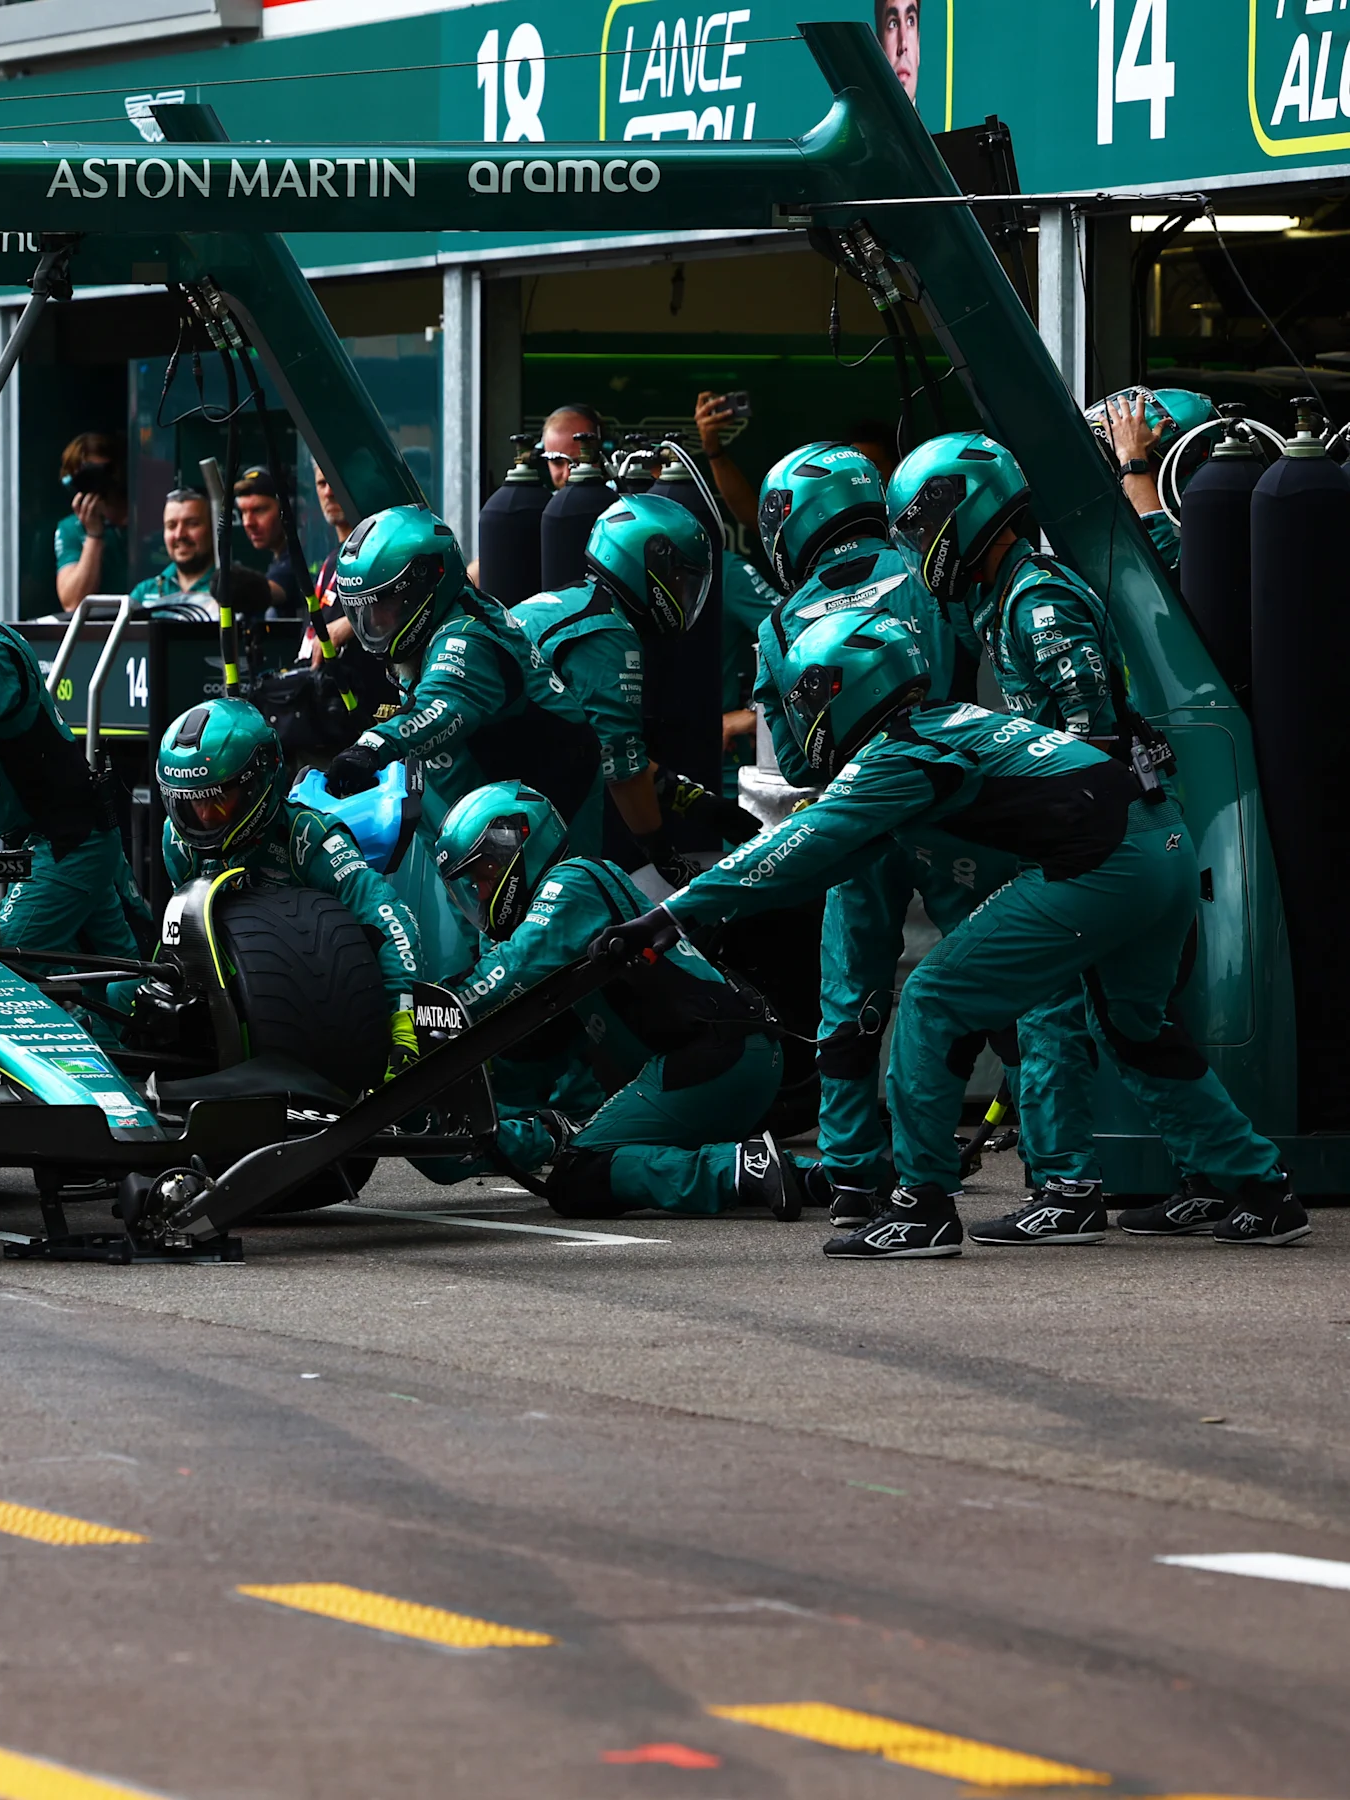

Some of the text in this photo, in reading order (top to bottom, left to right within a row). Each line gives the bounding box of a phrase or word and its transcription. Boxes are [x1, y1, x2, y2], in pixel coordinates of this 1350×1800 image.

[619, 8, 751, 104] LANCE
[1090, 0, 1175, 145] 14
[46, 158, 415, 199] ASTON MARTIN
[468, 159, 661, 193] aramco
[833, 541, 859, 555] BOSS
[931, 538, 950, 588] cognizant
[652, 586, 679, 629] cognizant
[826, 588, 877, 611] ASTON MARTIN
[397, 608, 432, 652] cognizant
[1031, 630, 1064, 645] EPOS
[1036, 638, 1073, 661] PIRELLI
[437, 653, 466, 668] EPOS
[126, 656, 148, 708] 14
[398, 698, 448, 739] aramco
[810, 728, 827, 769] cognizant
[163, 766, 208, 778] aramco
[182, 785, 223, 801] MARTIN
[231, 800, 269, 846] cognizant
[330, 850, 359, 868] EPOS
[739, 823, 816, 888] cognizant
[497, 875, 519, 926] cognizant
[968, 879, 1013, 924] ASTON
[377, 903, 417, 972] aramco
[4, 1033, 88, 1041] NetApp
[415, 1005, 463, 1030] AVATRADE
